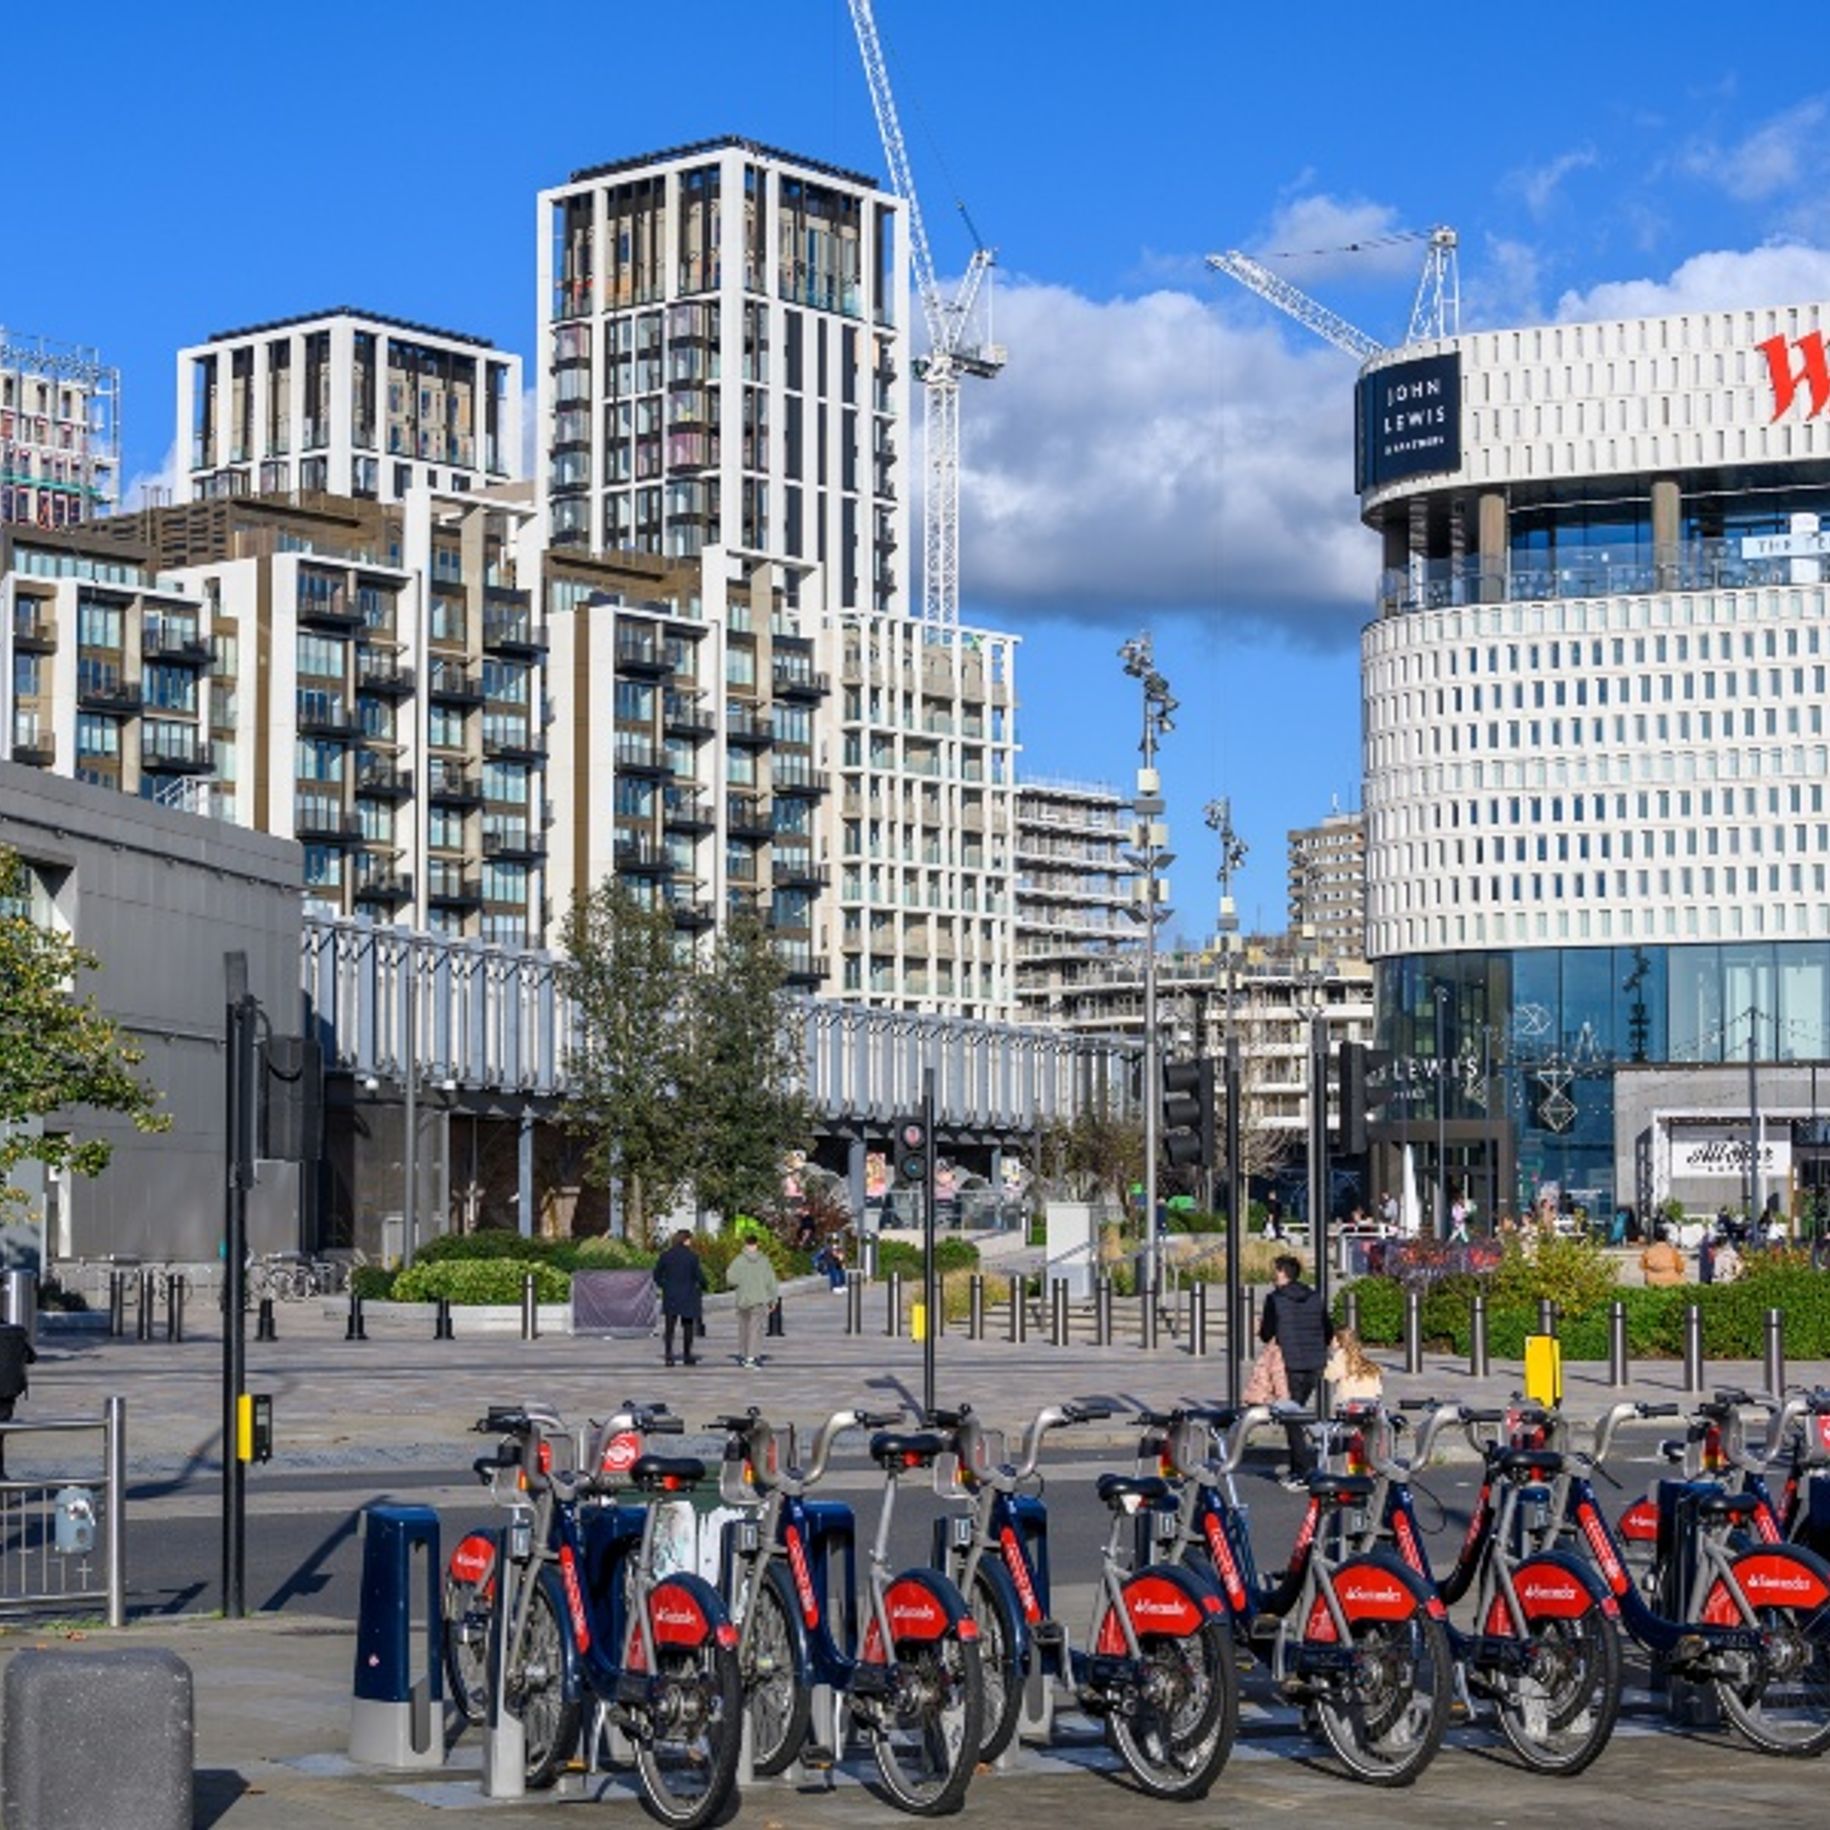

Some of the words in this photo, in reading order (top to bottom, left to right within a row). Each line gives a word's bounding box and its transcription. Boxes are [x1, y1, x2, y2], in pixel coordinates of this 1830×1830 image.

[1387, 378, 1441, 407] JOHN
[1384, 405, 1445, 435] LEWIS
[1393, 1056, 1478, 1081] LEWIS
